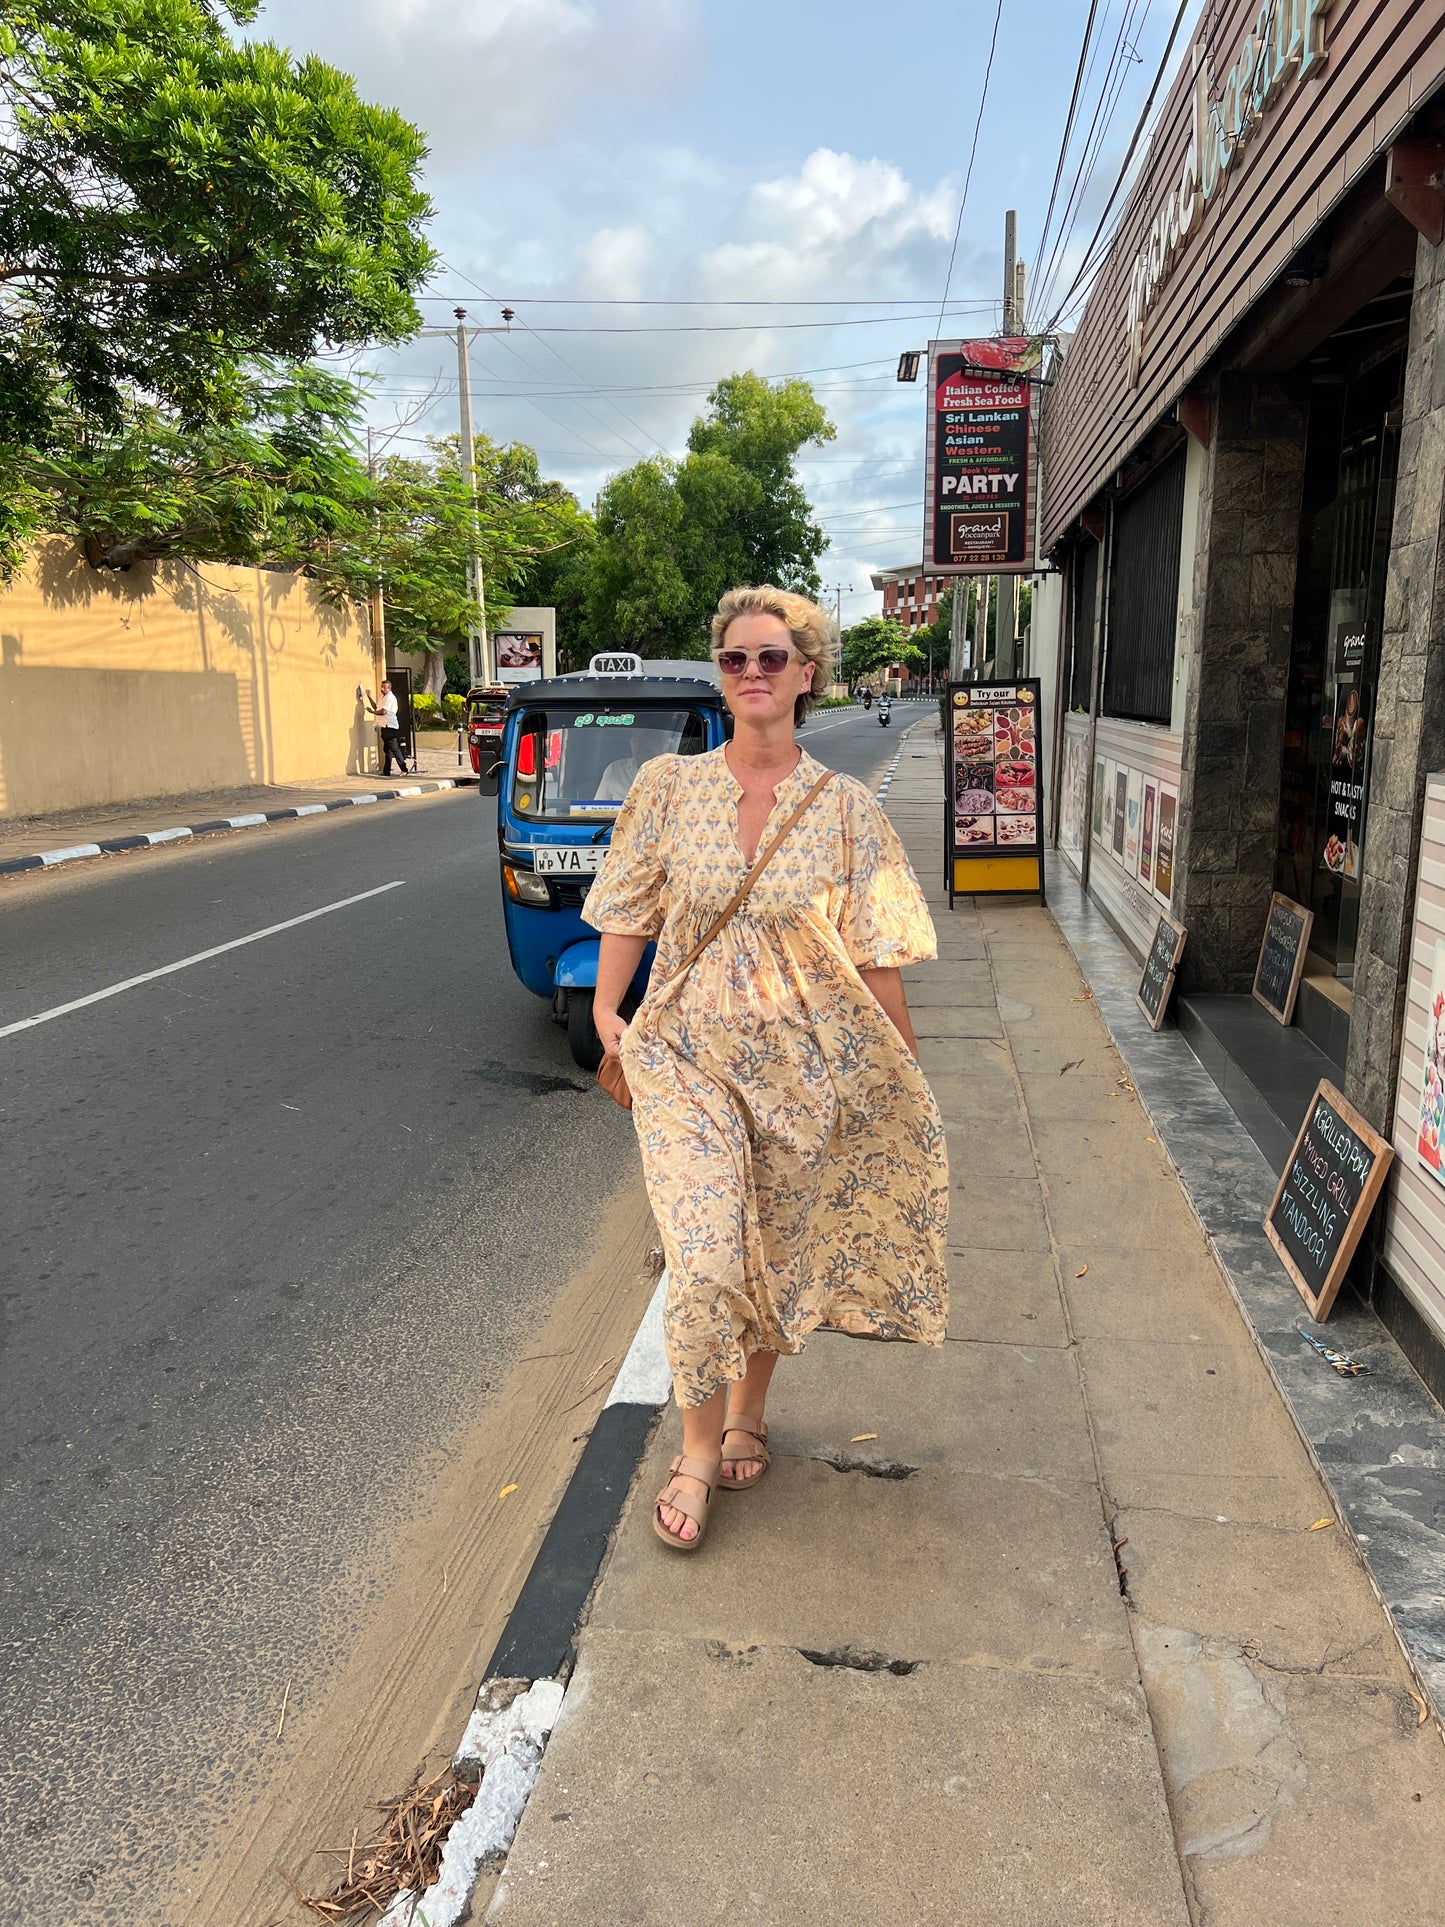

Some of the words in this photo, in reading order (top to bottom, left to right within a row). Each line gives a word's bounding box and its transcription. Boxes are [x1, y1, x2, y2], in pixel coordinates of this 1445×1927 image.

[946, 385, 982, 395] Italian
[985, 384, 1020, 394] Coffee
[943, 397, 973, 407] Fresh
[975, 396, 993, 406] Sea
[995, 394, 1022, 404] Food
[945, 413, 964, 423] Sri
[969, 412, 1019, 422] Lankan
[945, 424, 1000, 434] Chinese
[945, 435, 984, 445] Asian
[945, 446, 1001, 456] Western
[983, 466, 1000, 474] Your
[942, 473, 1019, 495] PARTY
[958, 516, 1001, 538] grand
[965, 531, 1000, 539] oceanpark
[599, 658, 632, 671] TAXI
[977, 690, 991, 699] Try
[993, 690, 1009, 698] our
[1331, 780, 1342, 795] HOT
[1316, 1109, 1351, 1161] GRILLED
[1304, 1140, 1329, 1179] MIXED
[1326, 1171, 1351, 1216] GRILL
[1293, 1166, 1337, 1240] SIZZLING
[1282, 1193, 1327, 1269] TANDOORI
